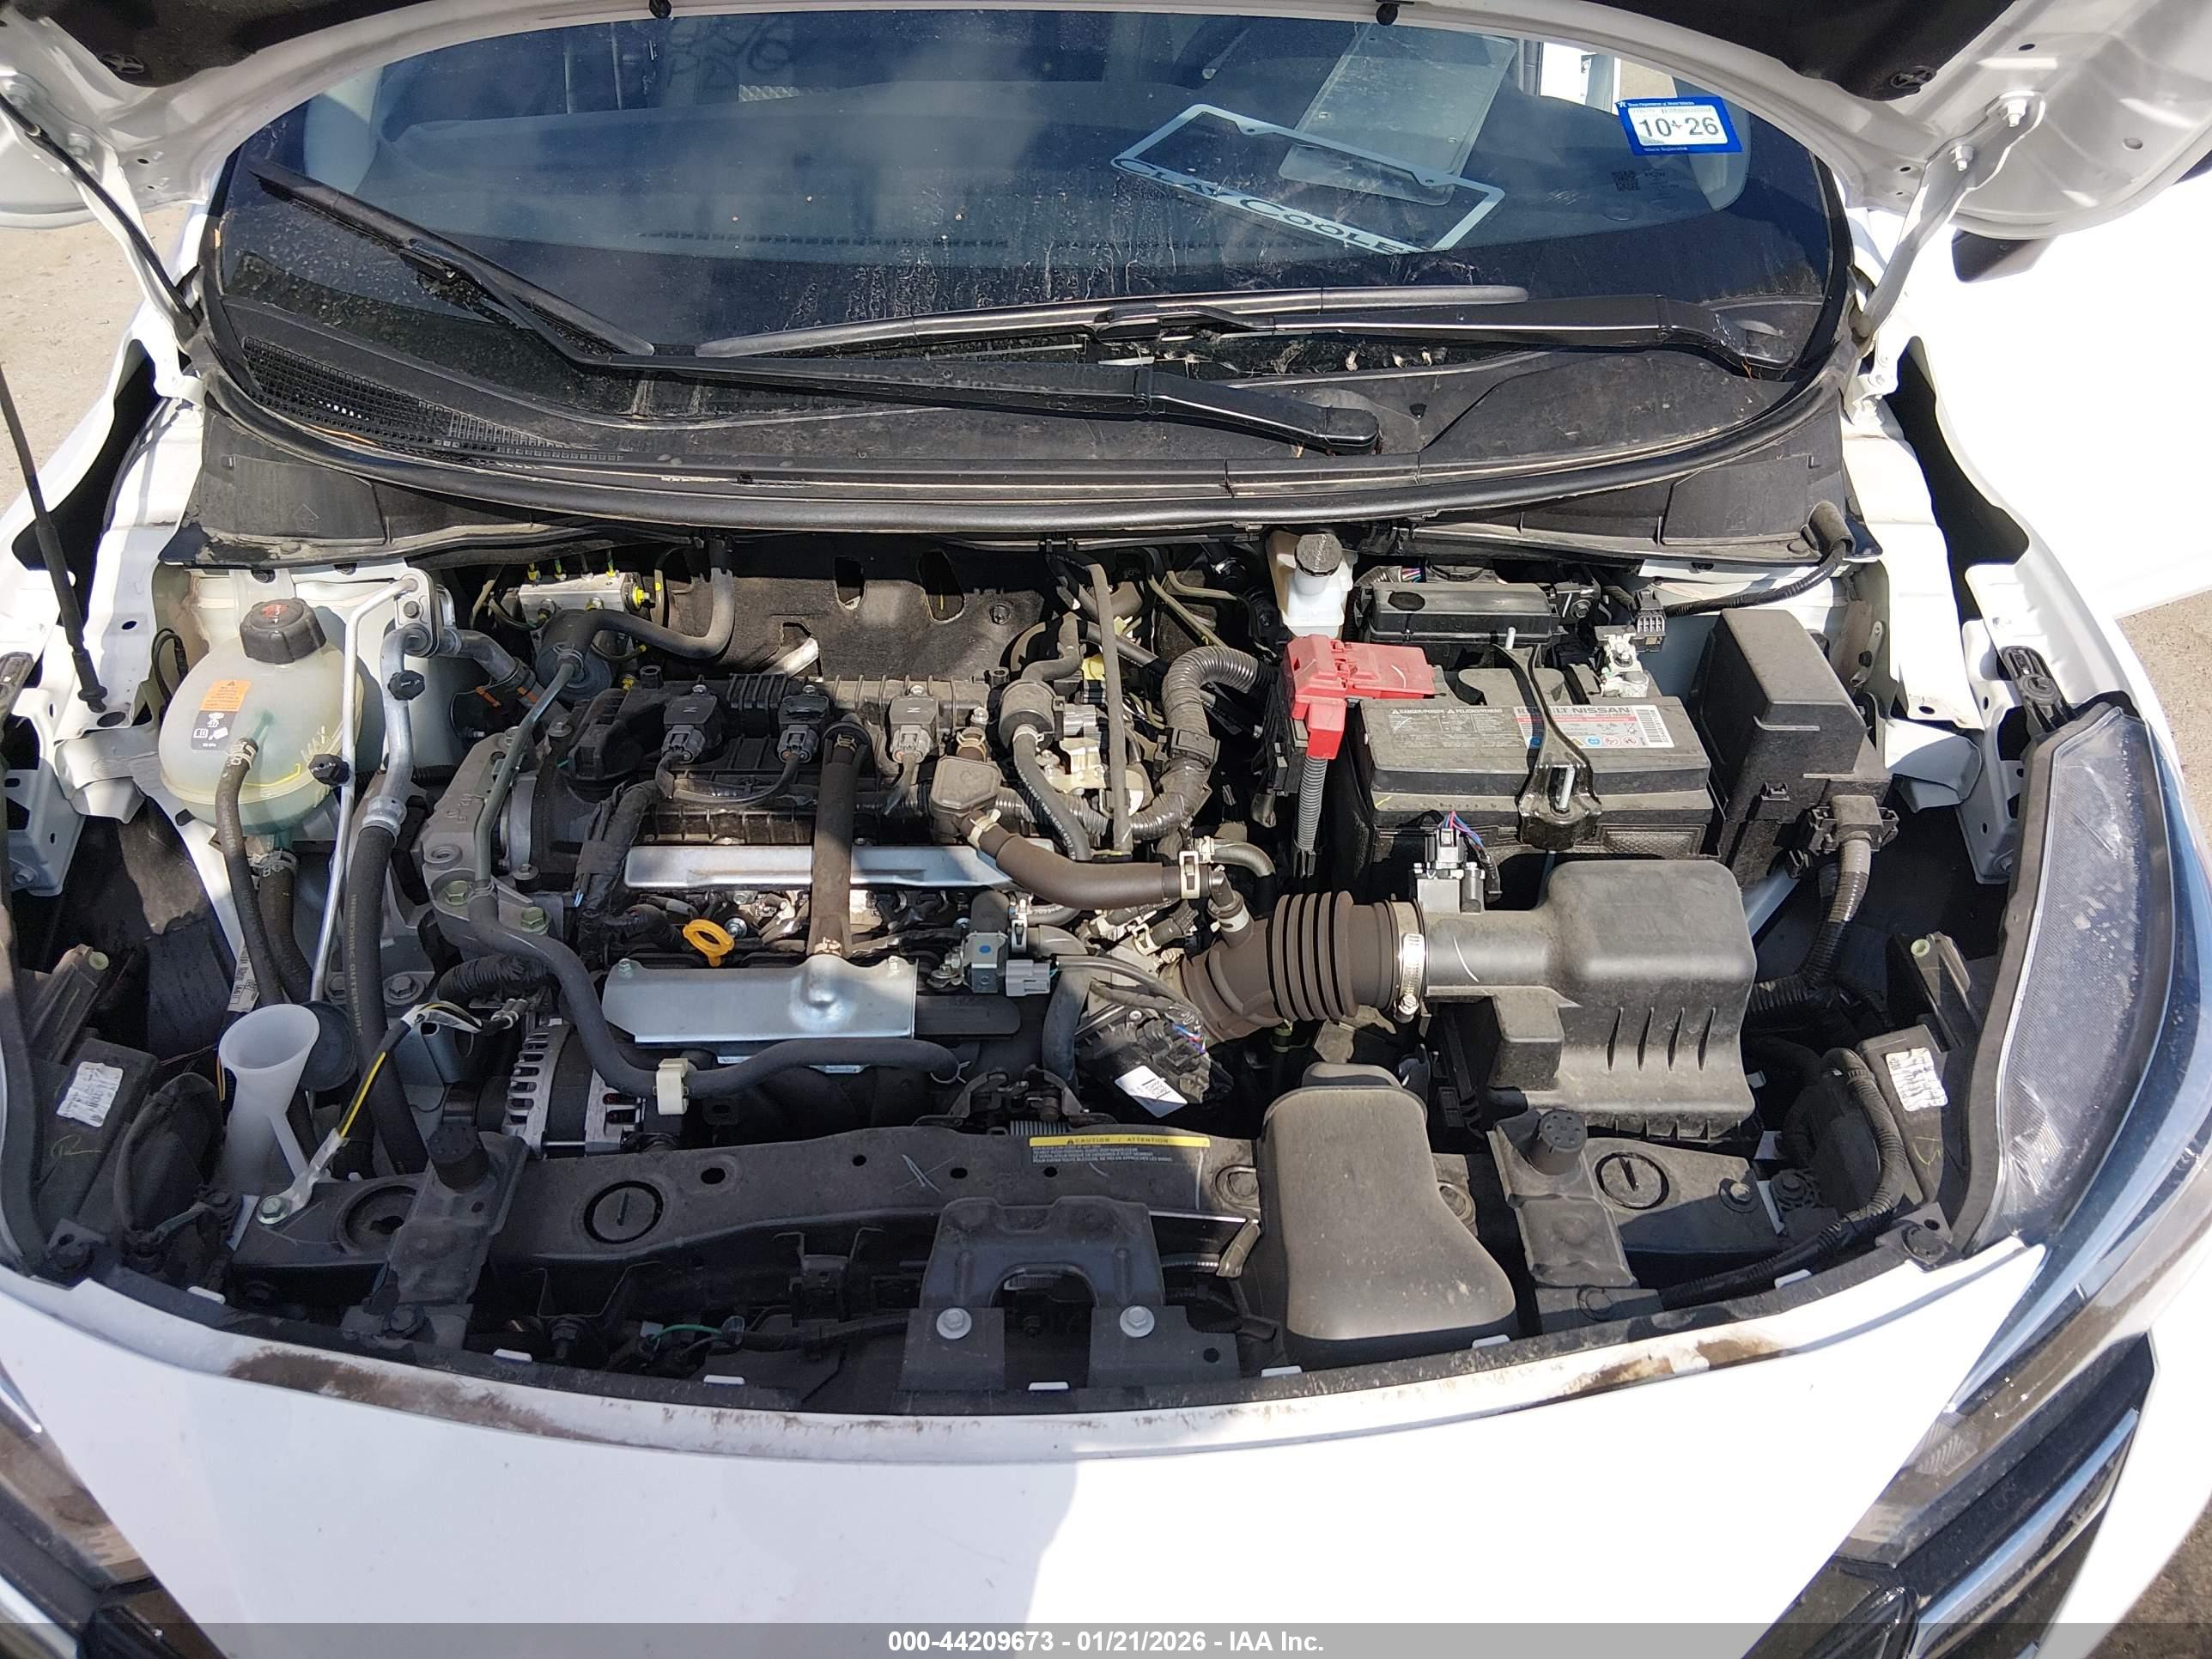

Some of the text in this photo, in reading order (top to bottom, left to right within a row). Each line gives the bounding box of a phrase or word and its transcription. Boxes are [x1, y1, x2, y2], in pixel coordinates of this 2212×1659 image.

[1638, 117, 1719, 137] 10 26
[1114, 158, 1413, 255] CLAY COOLE
